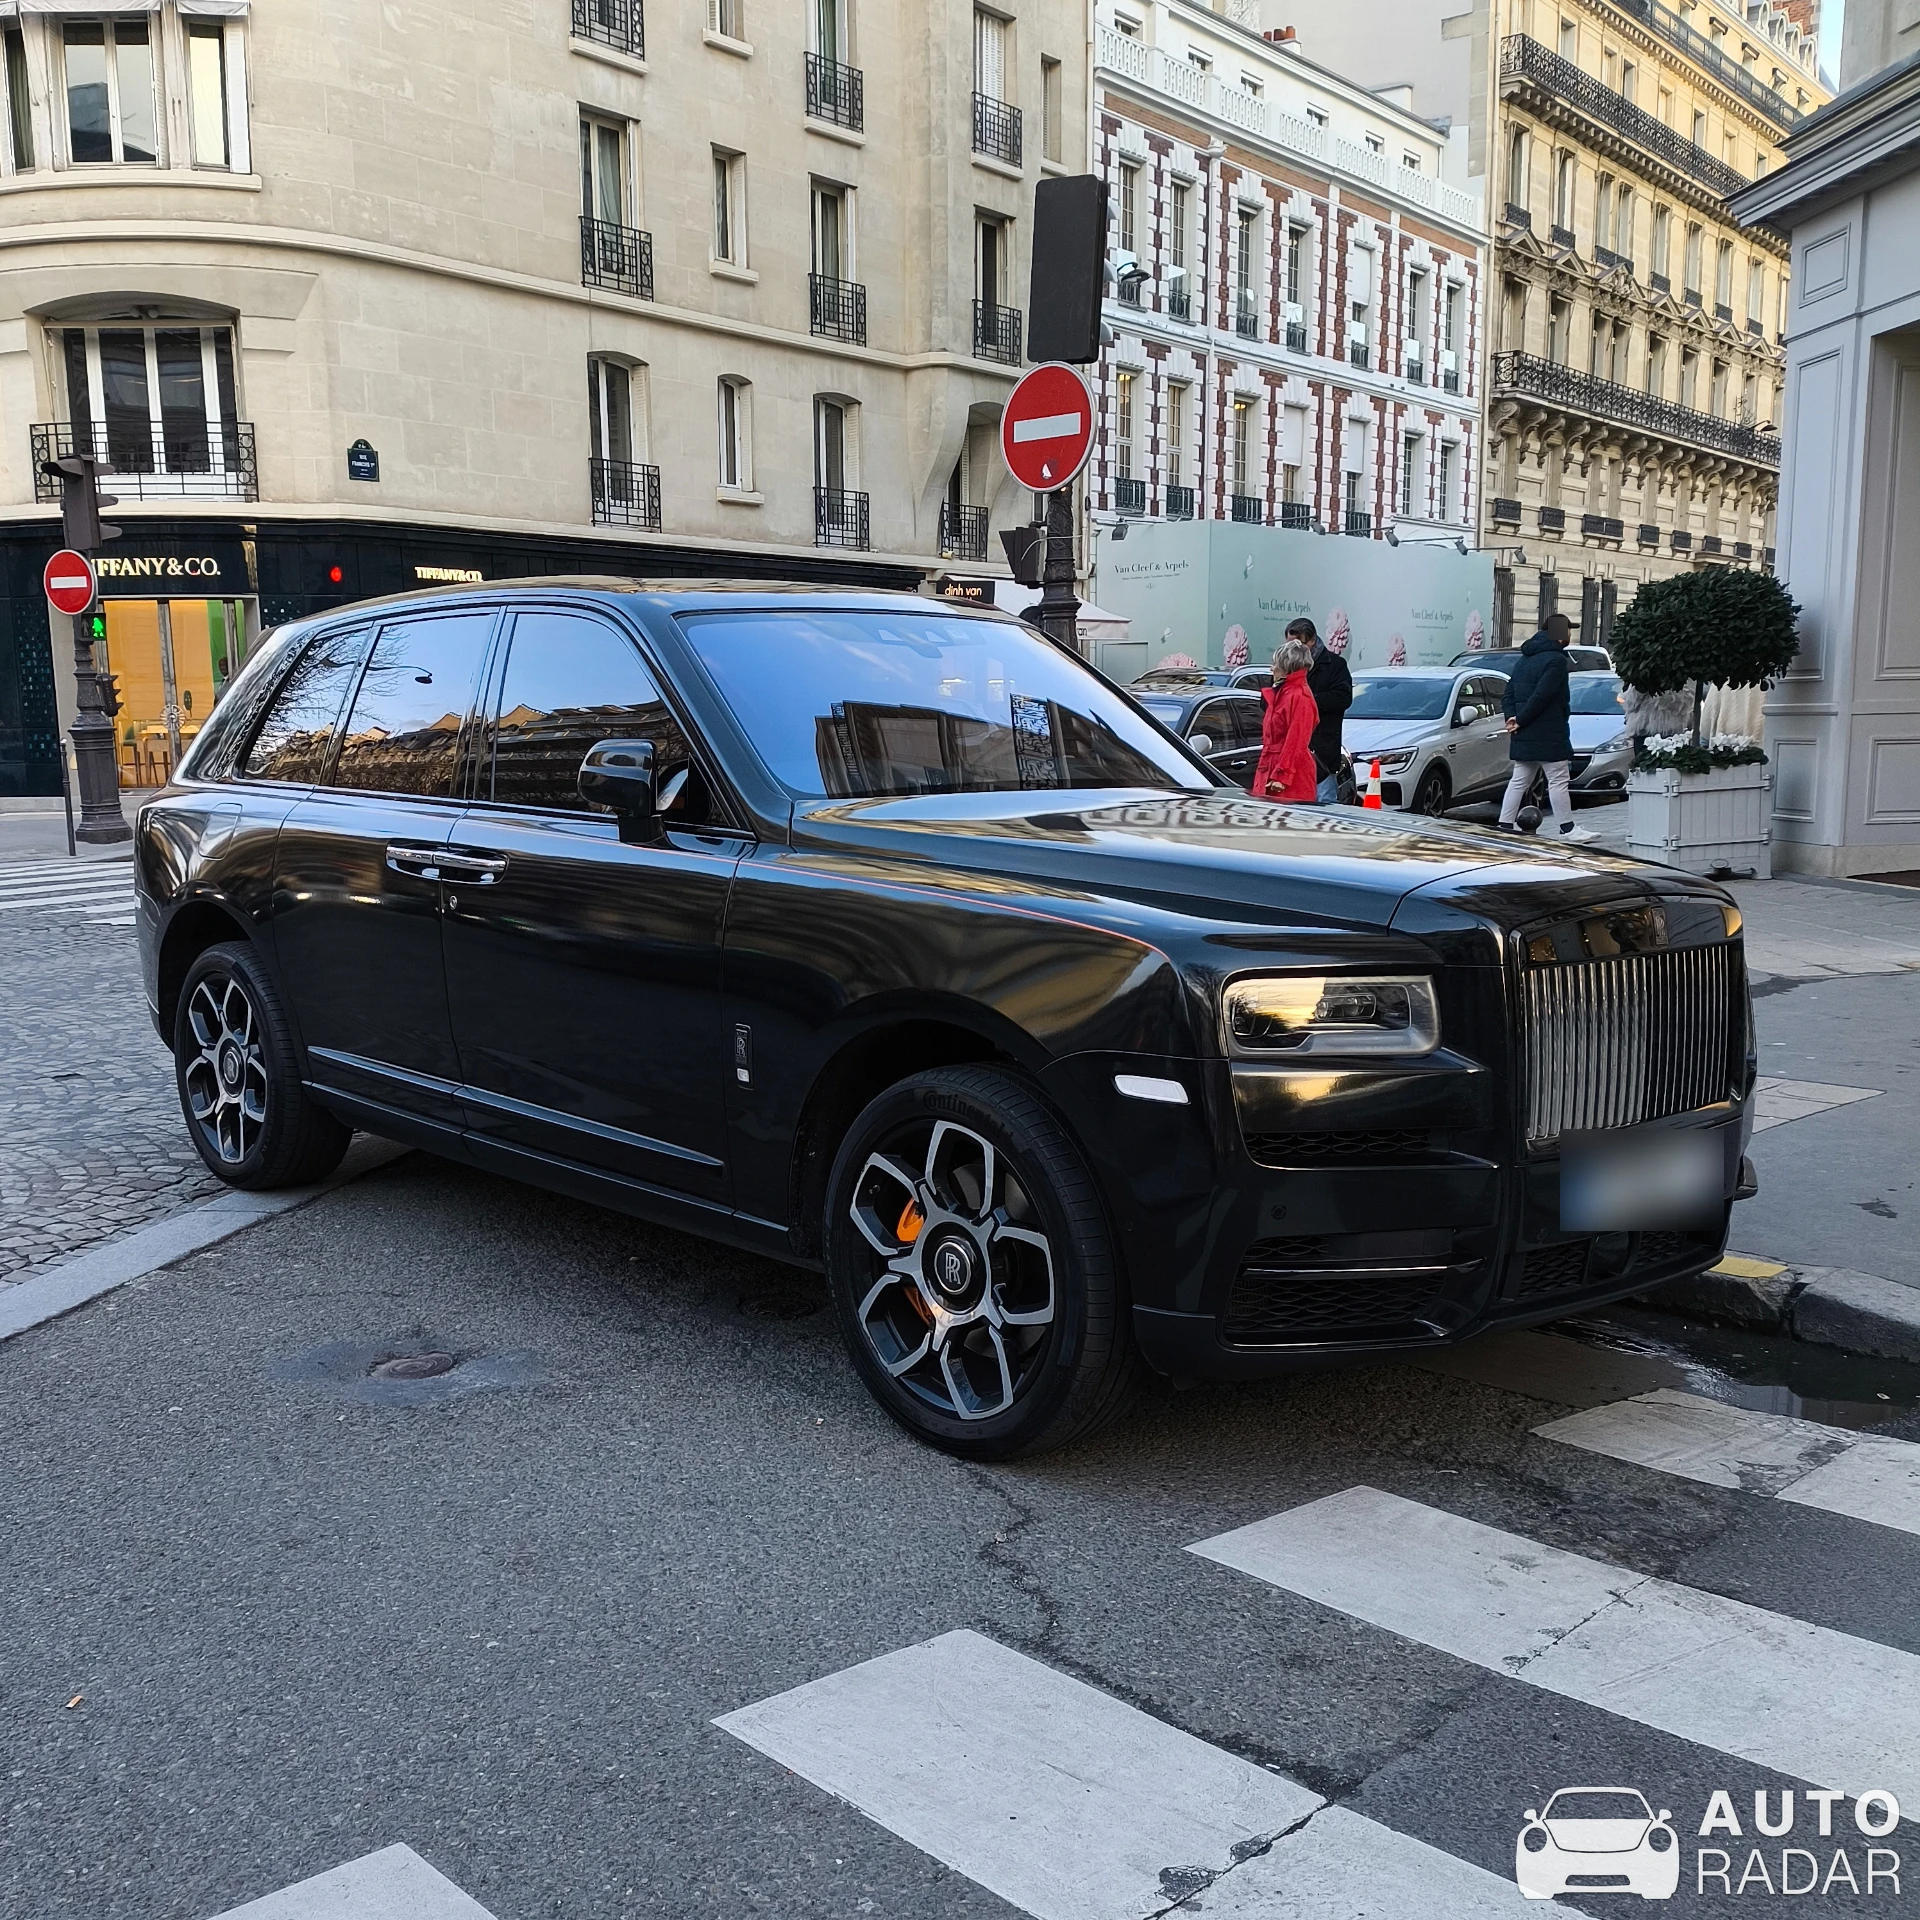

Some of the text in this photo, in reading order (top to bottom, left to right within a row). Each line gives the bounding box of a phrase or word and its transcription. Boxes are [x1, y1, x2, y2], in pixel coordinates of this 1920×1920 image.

[1114, 565, 1130, 573] Van
[1131, 562, 1154, 573] Cleef
[1165, 560, 1189, 572] Arpels
[944, 583, 982, 596] dinh van
[1258, 597, 1311, 616] Van Cleef & Arpels
[1076, 627, 1087, 636] an
[945, 1252, 961, 1284] RR
